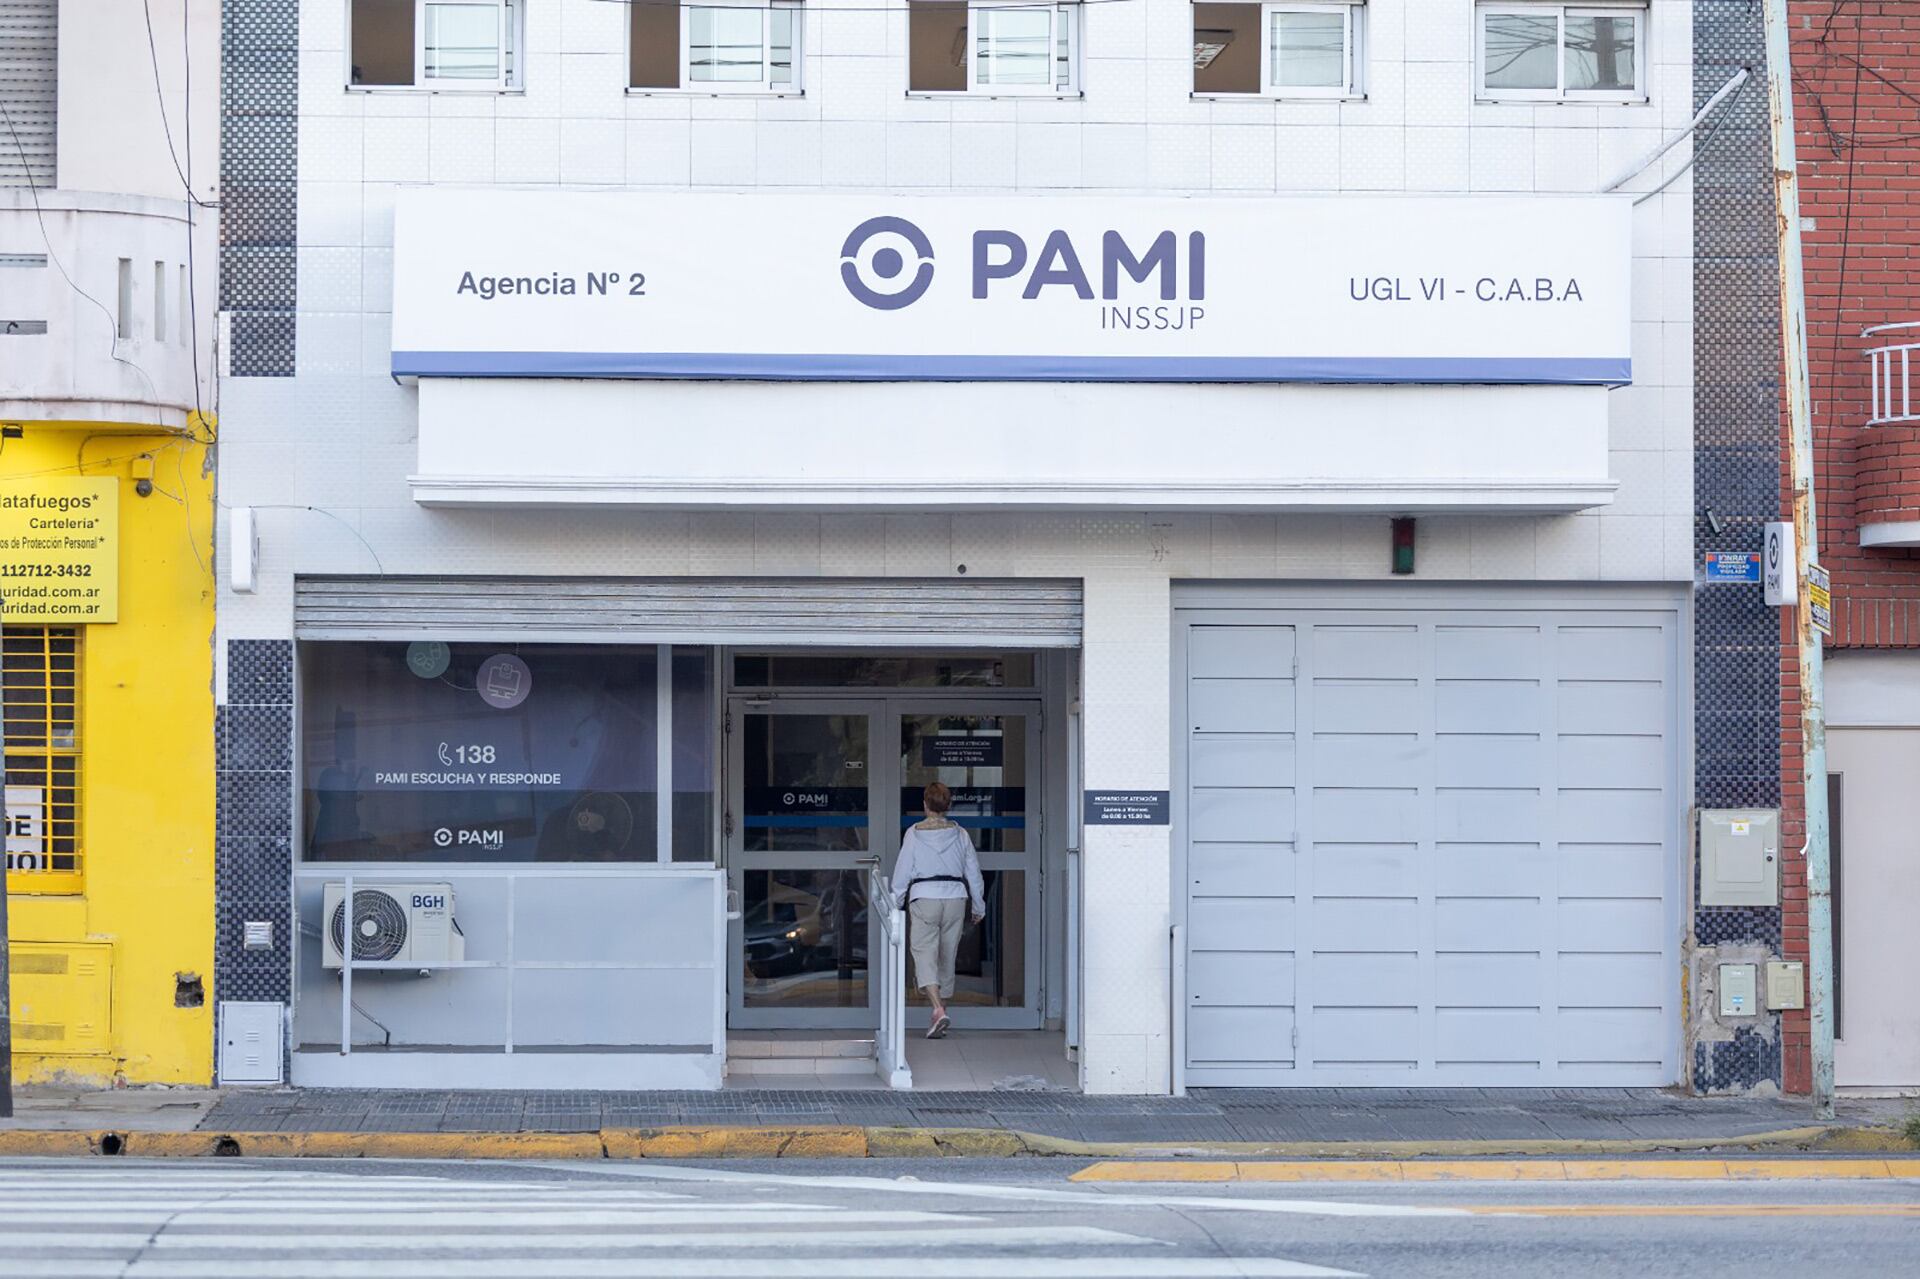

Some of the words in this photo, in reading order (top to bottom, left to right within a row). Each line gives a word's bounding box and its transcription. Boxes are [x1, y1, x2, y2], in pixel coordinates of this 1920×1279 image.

[972, 229, 1206, 301] PAMI
[456, 271, 576, 301] Agencia
[628, 272, 646, 296] 2
[1350, 277, 1412, 302] UGL
[1419, 278, 1444, 302] VI
[1475, 278, 1583, 302] C.A.B.A
[1102, 306, 1205, 330] INSSJP
[0, 493, 99, 512] atafuegos
[10, 537, 20, 549] de
[1, 564, 92, 577] 112712-3432
[0, 585, 100, 598] uridad.com.ar
[455, 745, 496, 764] 138
[375, 772, 408, 785] PAMI
[411, 772, 475, 785] ESCUCHA
[478, 773, 487, 785] Y
[489, 773, 561, 785] RESPONDE
[798, 793, 828, 804] PAMI
[950, 794, 993, 803] ami.org.ar
[458, 830, 504, 844] PAMI
[412, 895, 444, 908] BGH
